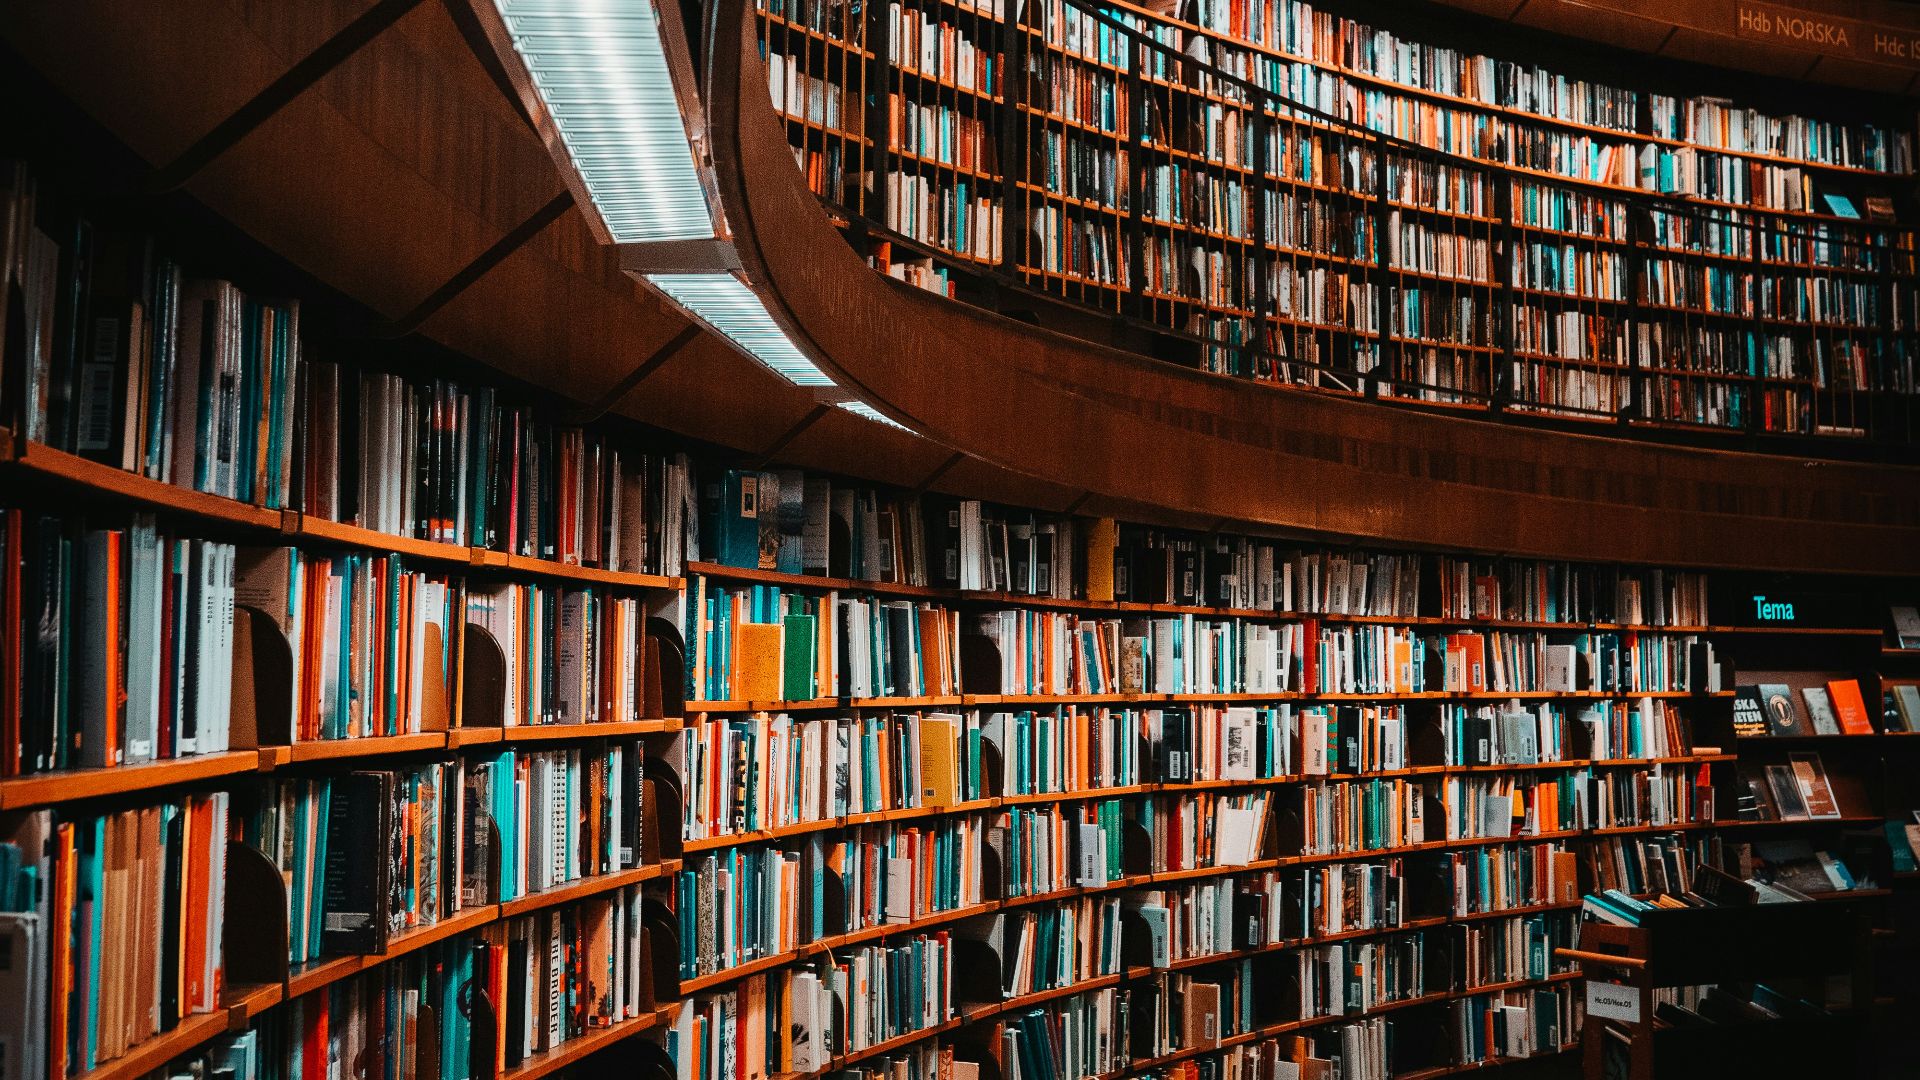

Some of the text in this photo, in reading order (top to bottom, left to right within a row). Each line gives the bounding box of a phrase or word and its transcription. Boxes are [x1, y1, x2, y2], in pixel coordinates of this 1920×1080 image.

[1740, 8, 1849, 48] Hdb NORSKA
[1874, 32, 1905, 57] Hdc
[1753, 595, 1795, 620] Tema
[1733, 698, 1759, 711] SKA
